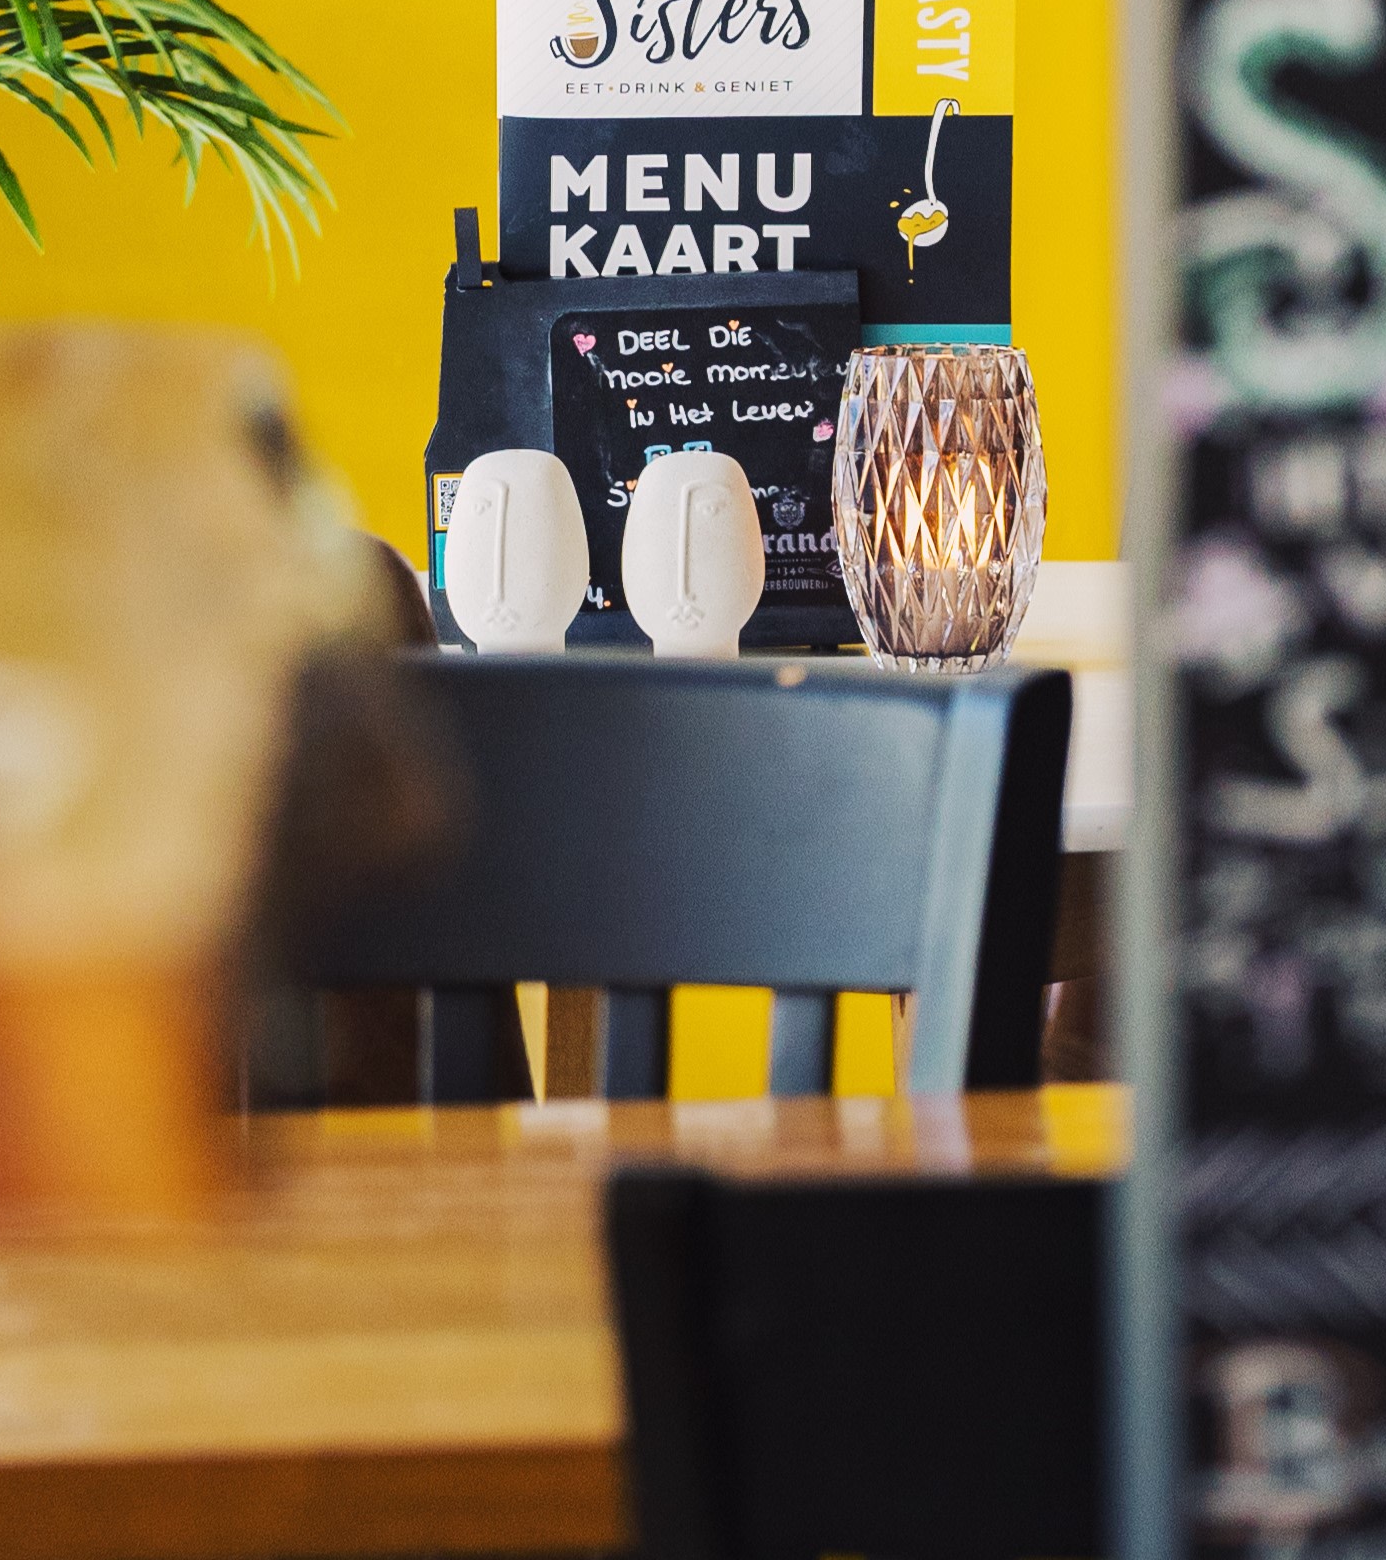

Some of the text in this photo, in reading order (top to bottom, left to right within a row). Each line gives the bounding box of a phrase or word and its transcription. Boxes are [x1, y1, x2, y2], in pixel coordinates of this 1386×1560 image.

[714, 80, 794, 93] GENIET
[550, 152, 812, 213] MENU
[549, 223, 811, 279] KAART
[617, 329, 691, 356] DEEL
[762, 526, 839, 554] rand
